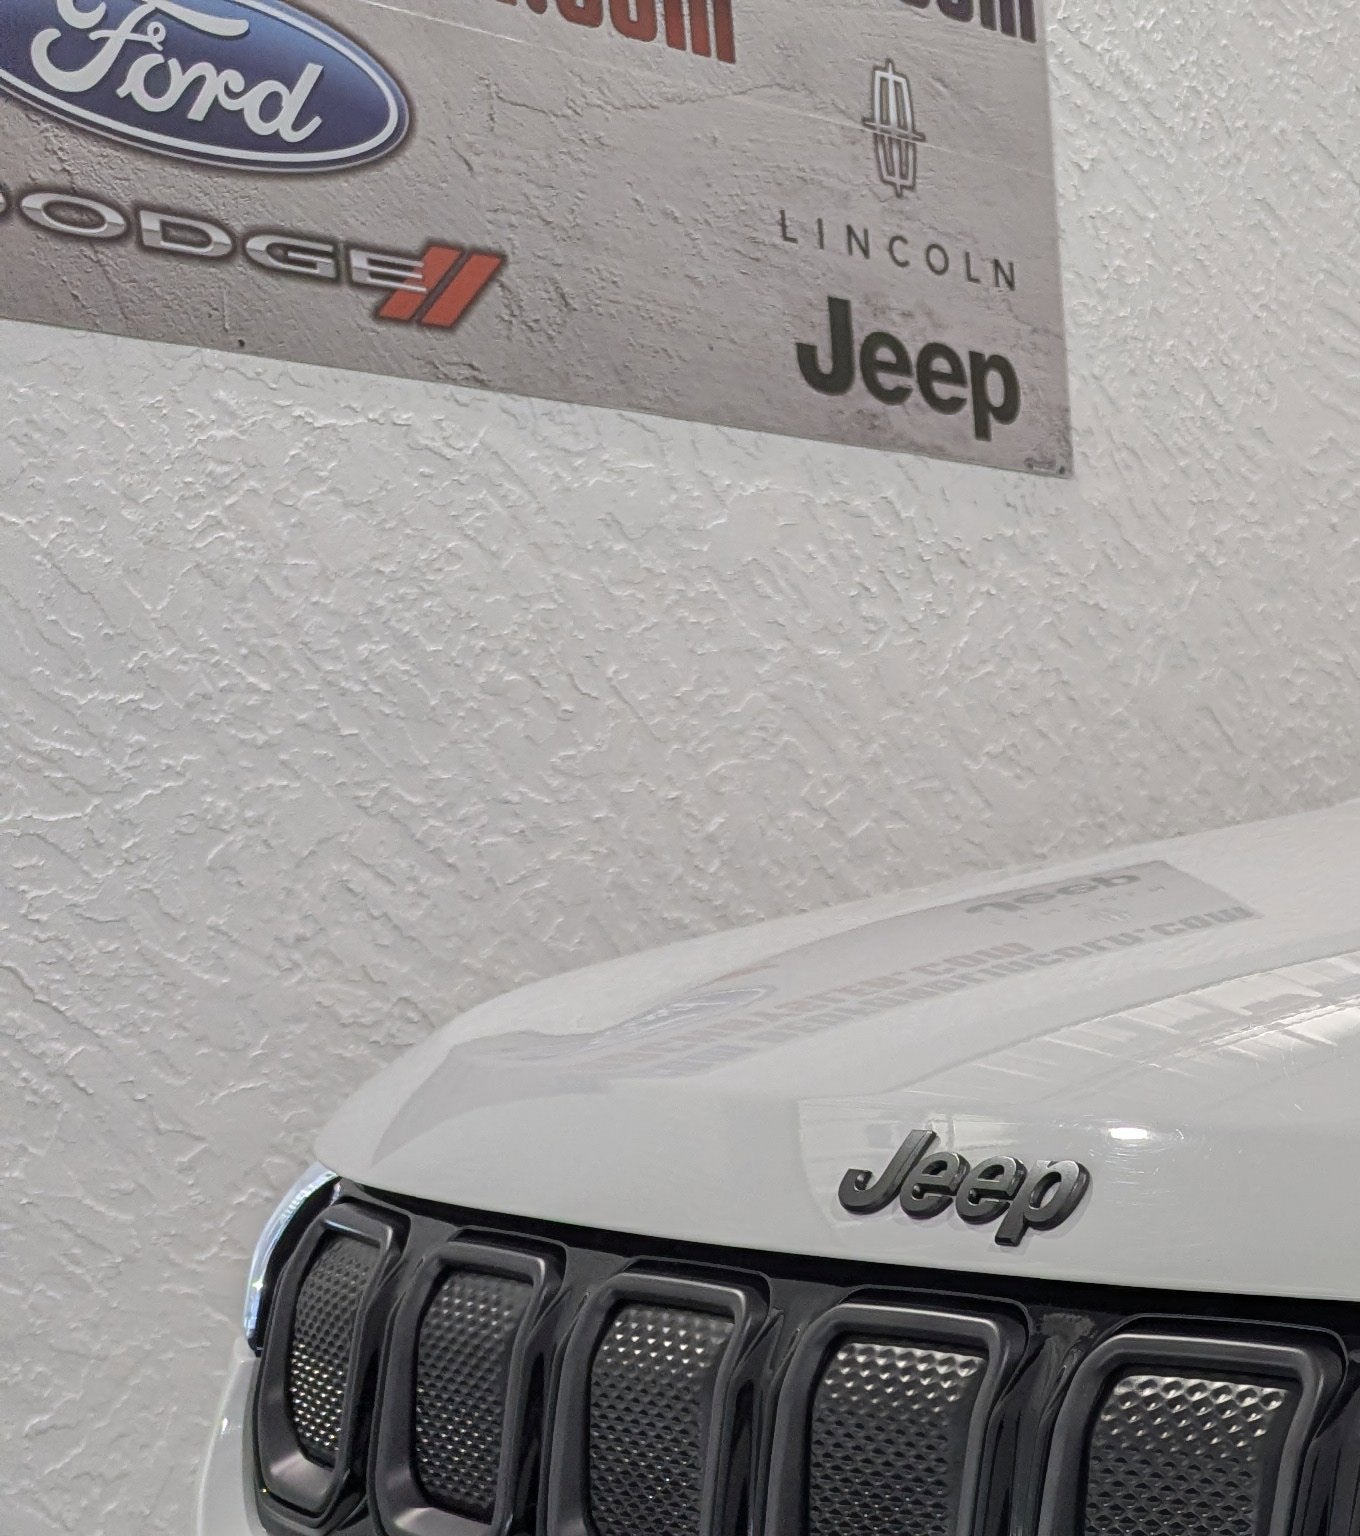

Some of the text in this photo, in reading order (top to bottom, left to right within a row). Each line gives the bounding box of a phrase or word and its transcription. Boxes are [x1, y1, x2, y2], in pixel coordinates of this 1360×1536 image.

[30, 0, 324, 143] Ford
[0, 192, 429, 295] ODGE
[780, 209, 1016, 292] LINCOLN
[795, 295, 1021, 442] Jeep
[838, 1129, 1090, 1246] Jeep
